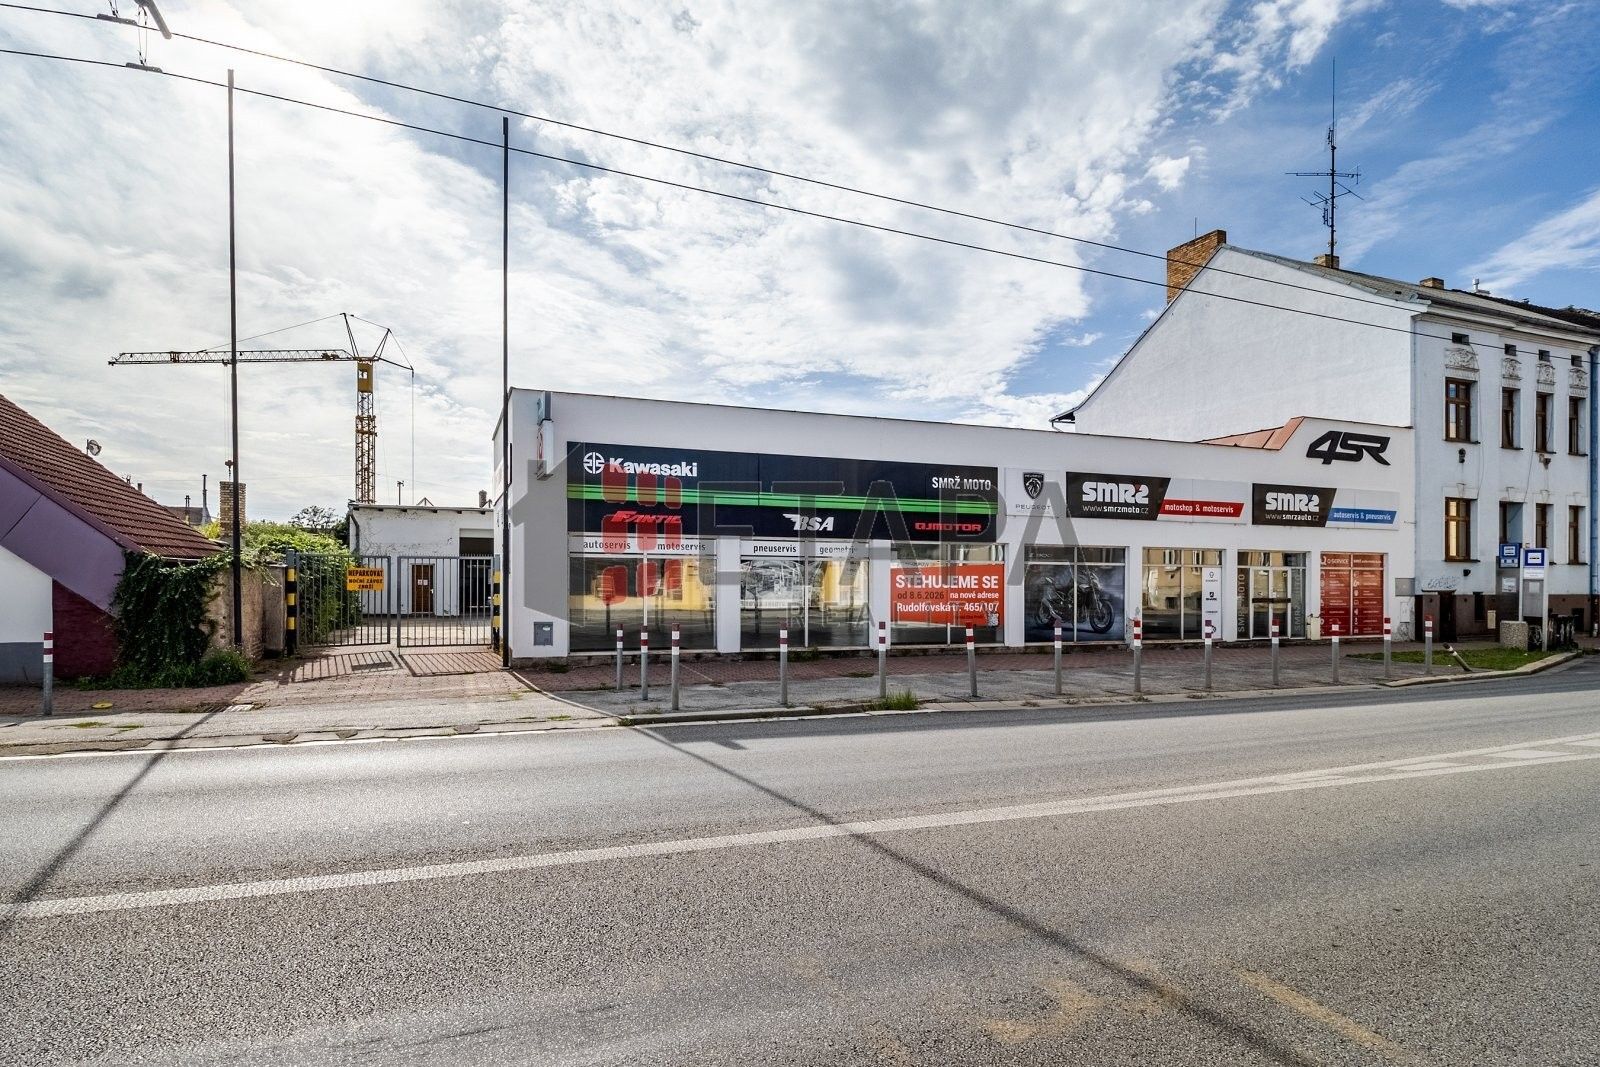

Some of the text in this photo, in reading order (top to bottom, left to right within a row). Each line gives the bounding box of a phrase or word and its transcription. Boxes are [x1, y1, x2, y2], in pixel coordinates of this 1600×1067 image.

[1306, 430, 1391, 465] 4SR
[609, 457, 698, 477] Kawasaki
[932, 476, 992, 491] SMRŽ MOTO
[1082, 505, 1149, 514] www.smrzmoto.cz
[1164, 503, 1193, 513] motoshop
[1202, 505, 1234, 513] motoservis
[611, 510, 682, 523] FANTIC
[1265, 513, 1320, 522] www.smrzauto.cz
[1333, 511, 1359, 519] autoservis
[1365, 512, 1392, 521] pneuservis
[794, 514, 835, 532] BSA
[915, 522, 982, 532] QJMOTOR
[583, 540, 631, 550] autoservis
[657, 541, 707, 551] motoservis
[753, 544, 797, 554] pneuservis
[819, 545, 857, 555] geometri
[895, 571, 999, 589] STĚHUJEME SE
[897, 591, 945, 600] od 8.6.2026
[960, 591, 976, 599] nové
[977, 591, 999, 599] adrese
[896, 602, 951, 612] Rudolfovská
[964, 603, 999, 613] 465/107
